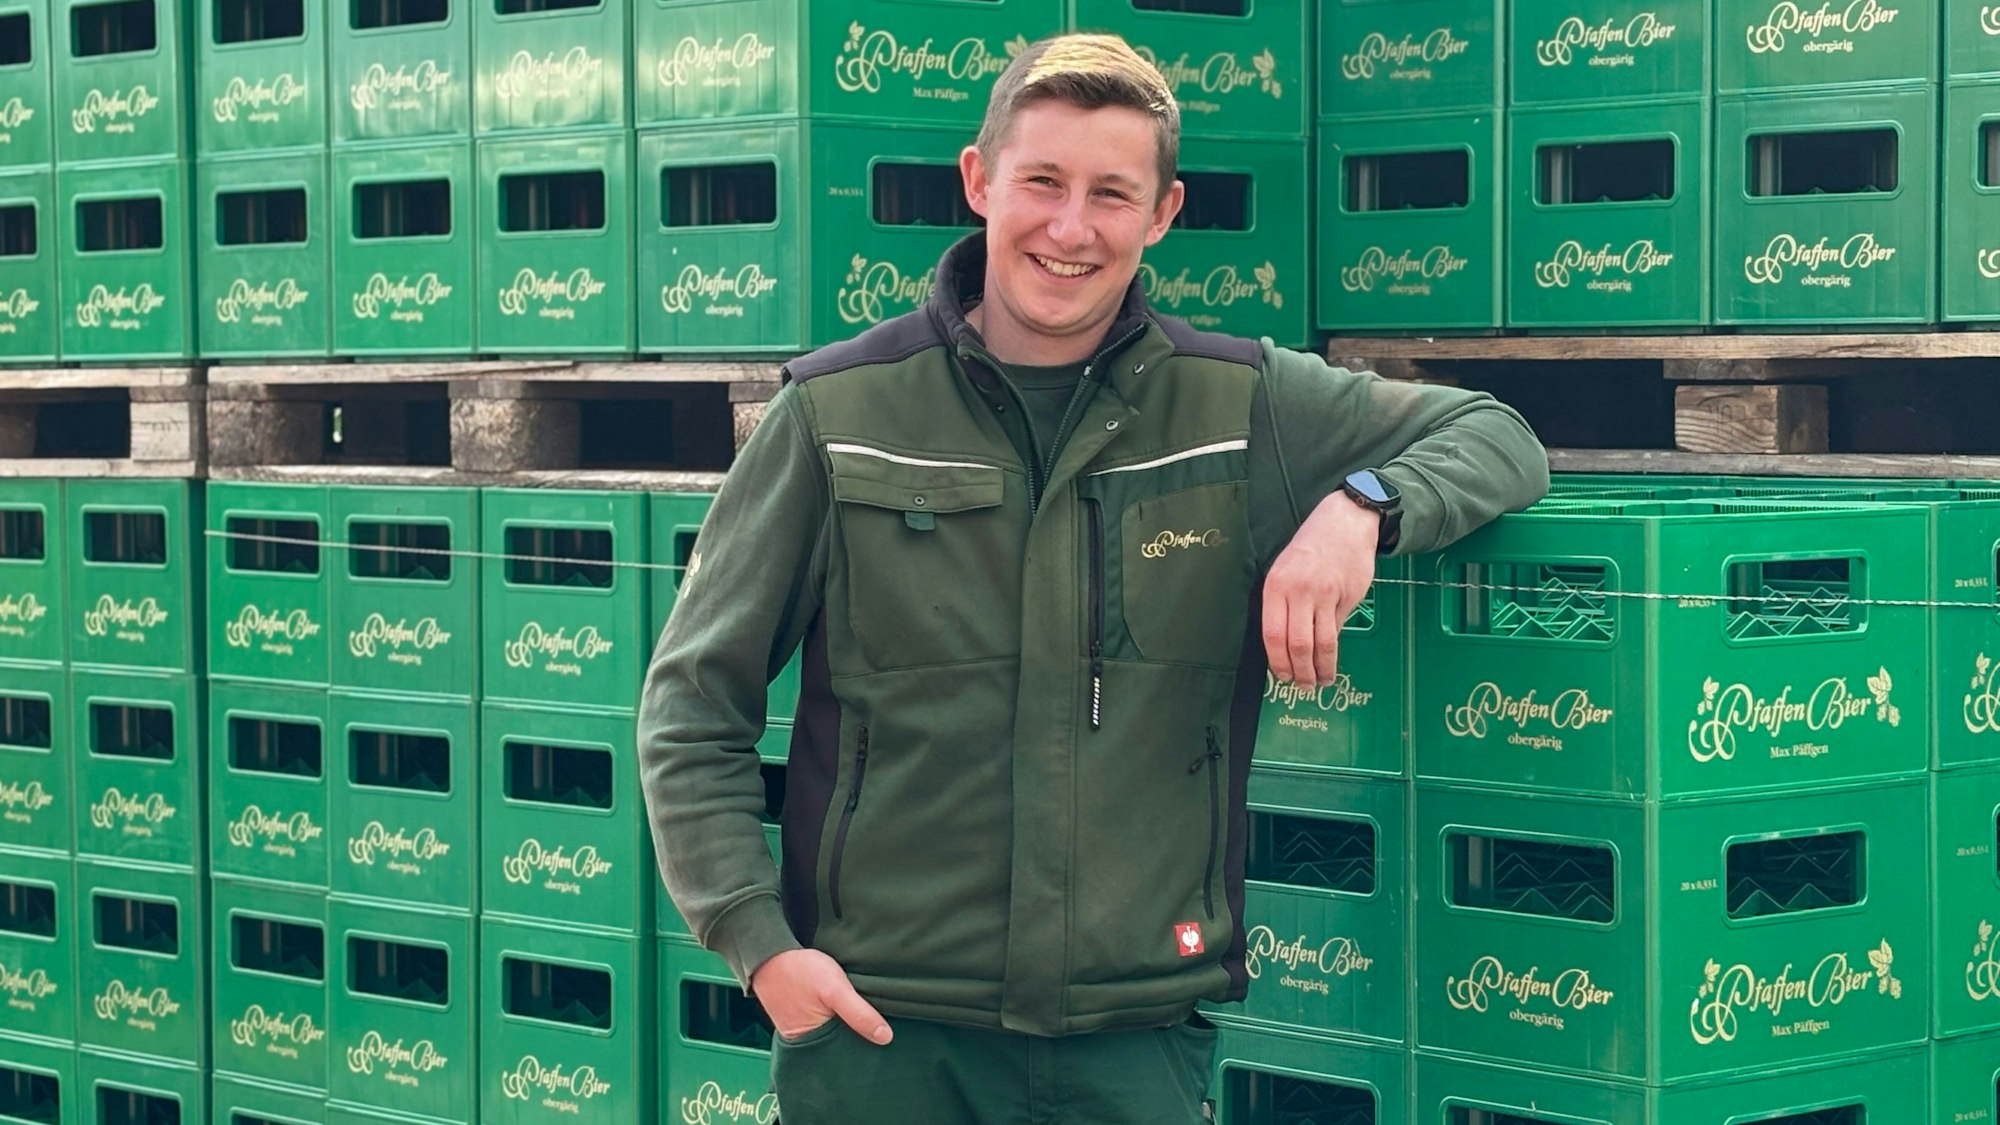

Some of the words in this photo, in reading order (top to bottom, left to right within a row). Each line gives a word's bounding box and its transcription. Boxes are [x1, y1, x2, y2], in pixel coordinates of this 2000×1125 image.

[1537, 16, 1623, 66] Pfaffen
[1624, 12, 1675, 47] Bier
[1747, 1, 1840, 53] Pfaffen
[1842, 0, 1899, 32] Bier
[1803, 39, 1853, 54] obergärig
[496, 50, 562, 98] Pfaffen
[563, 46, 601, 80] Bier
[658, 36, 731, 86] Pfaffen
[732, 32, 775, 68] Bier
[835, 30, 945, 93] Pfaffen
[948, 37, 1009, 81] Bier
[1201, 52, 1257, 93] Bier
[1342, 32, 1421, 79] Pfaffen
[1422, 28, 1468, 61] Bier
[1389, 67, 1431, 80] obergärig
[1588, 53, 1635, 66] obergärig
[213, 76, 271, 122] Pfaffen
[272, 73, 305, 105] Bier
[352, 63, 413, 109] Pfaffen
[414, 60, 450, 93] Bier
[912, 87, 932, 98] Max
[934, 88, 969, 101] Päffgen
[72, 89, 126, 133] Pfaffen
[127, 85, 159, 117] Bier
[1341, 246, 1420, 292] Pfaffen
[1421, 246, 1467, 278] Bier
[1535, 240, 1620, 288] Pfaffen
[1622, 240, 1672, 273] Bier
[1745, 234, 1838, 284] Pfaffen
[1840, 233, 1895, 268] Bier
[217, 278, 274, 322] Pfaffen
[275, 278, 308, 309] Bier
[353, 273, 416, 318] Pfaffen
[417, 272, 452, 304] Bier
[499, 268, 566, 315] Pfaffen
[567, 268, 605, 301] Bier
[662, 265, 733, 313] Pfaffen
[734, 264, 777, 298] Bier
[838, 262, 936, 323] Pfaffe
[1203, 266, 1258, 306] Bier
[1388, 284, 1430, 295] obergärig
[1586, 279, 1632, 292] obergärig
[1801, 275, 1851, 288] obergärig
[77, 284, 132, 327] Pfaffen
[133, 283, 165, 314] Bier
[705, 304, 743, 317] obergärig
[1141, 529, 1201, 558] Pfaffen
[85, 594, 138, 636] Pfaffen
[139, 598, 168, 627] Bier
[227, 604, 285, 647] Pfaffen
[286, 609, 320, 640] Bier
[351, 612, 413, 658] Pfaffen
[414, 617, 450, 649] Bier
[505, 622, 572, 668] Pfaffen
[573, 626, 613, 659] Bier
[1318, 673, 1373, 711] Bier
[1445, 682, 1549, 738] Pfaffen
[1551, 689, 1612, 730] Bier
[1279, 714, 1329, 732] obergärig
[1508, 733, 1563, 750] obergärig
[1689, 683, 1805, 762] Pfaffen
[1807, 677, 1871, 730] Bier
[1770, 746, 1790, 758] Max
[1792, 744, 1829, 757] Päffgen
[91, 787, 145, 829] Pfaffen
[146, 793, 176, 822] Bier
[228, 804, 288, 847] Pfaffen
[289, 811, 323, 842] Bier
[349, 821, 413, 866] Pfaffen
[414, 828, 450, 860] Bier
[503, 838, 572, 884] Pfaffen
[573, 846, 612, 878] Bier
[1245, 925, 1317, 979] Pfaffen
[1319, 937, 1373, 976] Bier
[94, 979, 148, 1021] Pfaffen
[149, 987, 180, 1017] Bier
[1280, 975, 1329, 994] obergärig
[1447, 956, 1551, 1012] Pfaffen
[1552, 968, 1613, 1010] Bier
[1690, 964, 1806, 1045] Pfaffen
[1808, 953, 1873, 1007] Bier
[231, 1004, 290, 1047] Pfaffen
[291, 1013, 325, 1045] Bier
[1509, 1008, 1564, 1030] obergärig
[1771, 1026, 1791, 1037] Max
[1793, 1019, 1830, 1036] Päffgen
[347, 1030, 411, 1075] Pfaffen
[412, 1039, 448, 1072] Bier
[502, 1055, 571, 1101] Pfaffen
[572, 1065, 611, 1099] Bier
[681, 1080, 755, 1125] Pfaffen
